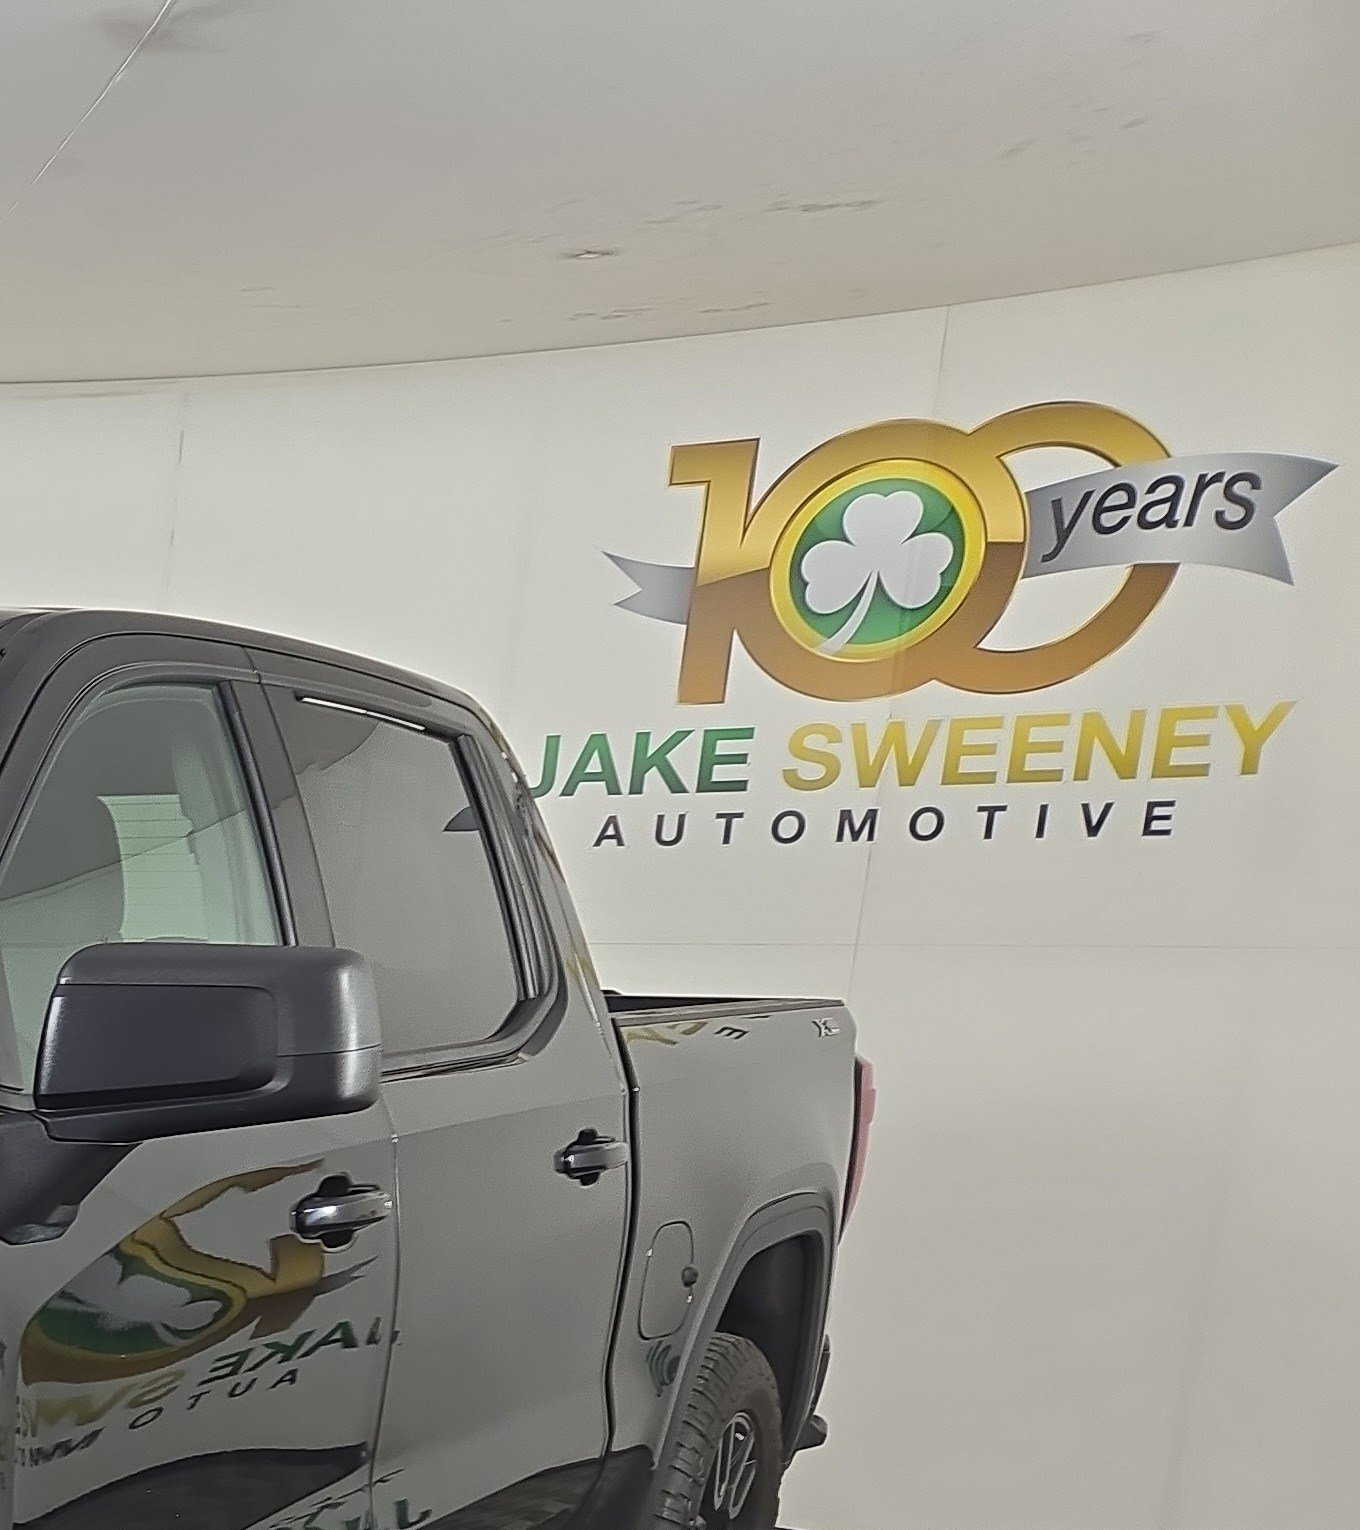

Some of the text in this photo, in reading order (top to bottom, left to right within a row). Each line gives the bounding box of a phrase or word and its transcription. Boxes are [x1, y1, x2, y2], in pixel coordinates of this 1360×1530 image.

[1041, 470, 1262, 562] years
[532, 700, 1297, 798] JAKE SWEENEY
[592, 799, 1179, 848] AUTOMOTIVE
